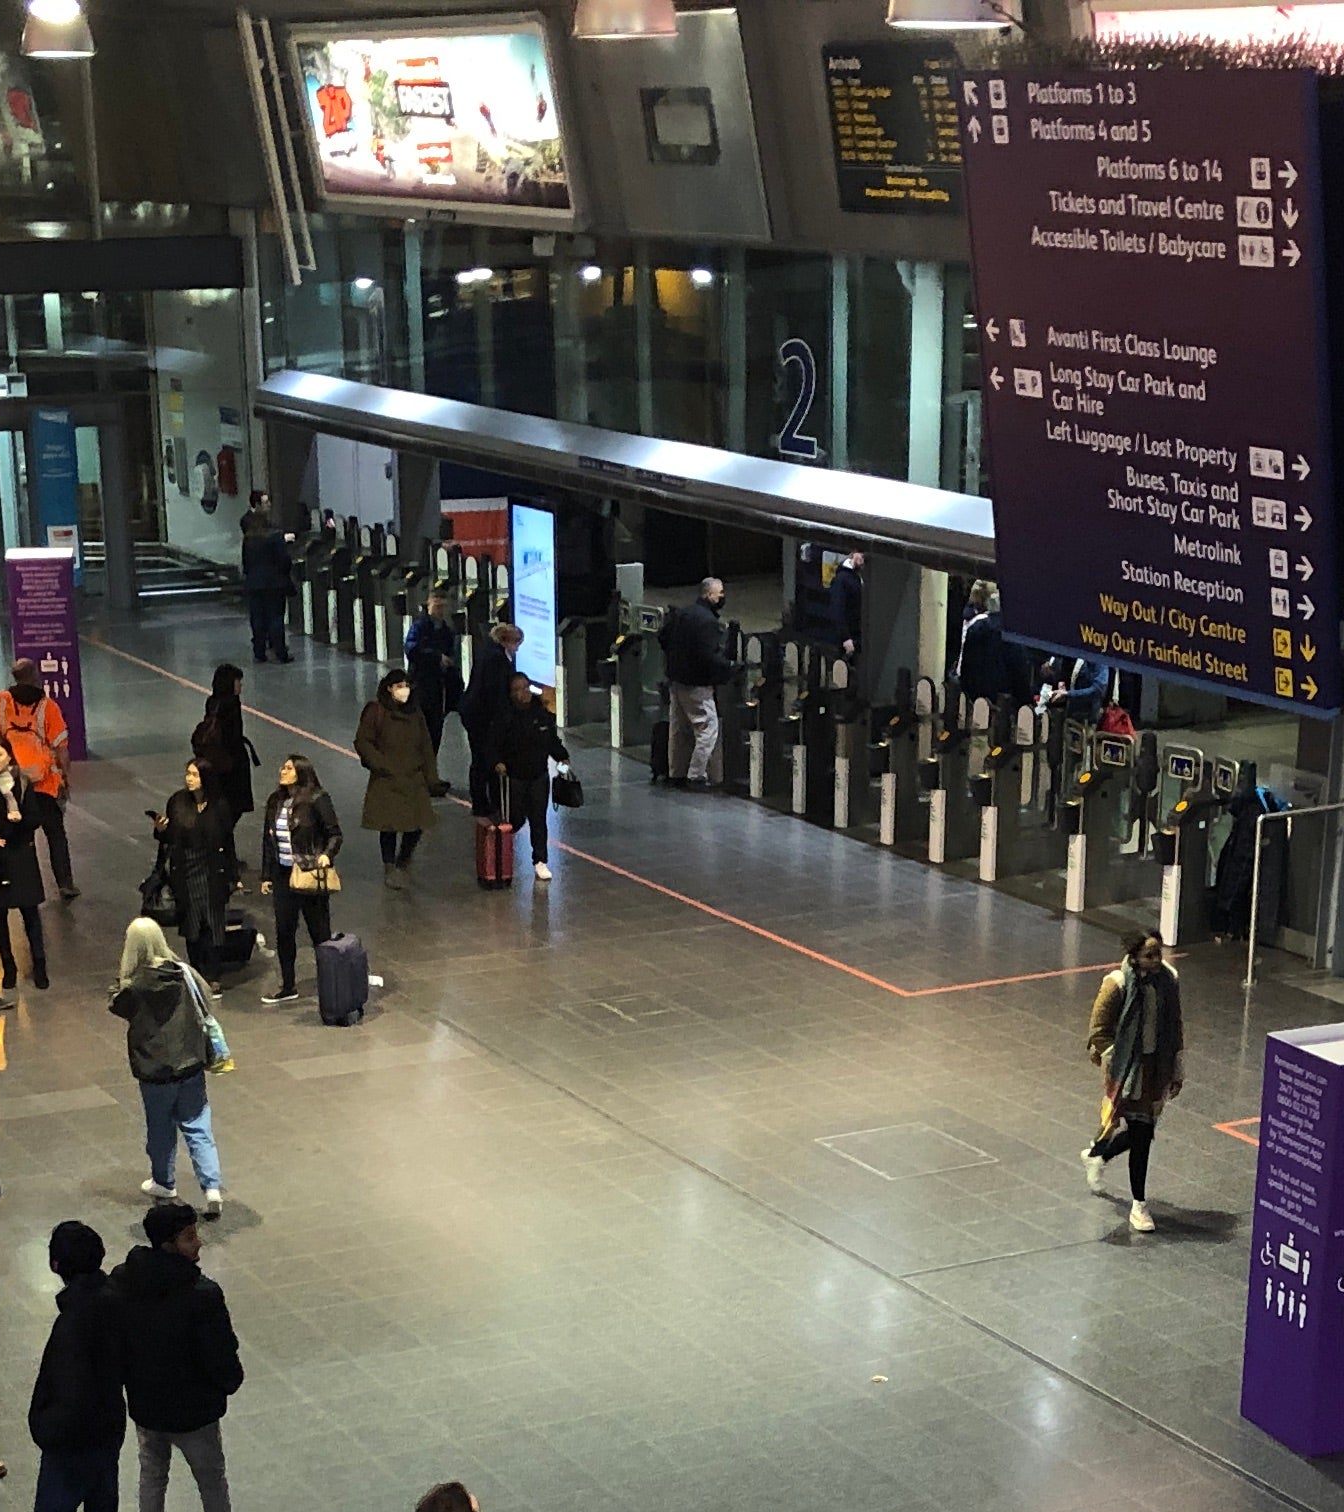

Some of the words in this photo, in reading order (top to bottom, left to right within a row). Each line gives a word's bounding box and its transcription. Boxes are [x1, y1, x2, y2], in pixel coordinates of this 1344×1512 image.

[1027, 82, 1092, 104] Platforms
[1097, 83, 1104, 103] 1
[1108, 85, 1126, 104] to
[1127, 82, 1137, 105] 3
[1030, 118, 1095, 141] Platforms
[1098, 119, 1107, 141] 4
[1111, 120, 1137, 142] and
[1142, 120, 1152, 143] 5
[1097, 157, 1165, 180] Platforms
[1168, 158, 1178, 181] 6
[1182, 160, 1199, 181] to
[1203, 160, 1223, 181] 14
[1049, 191, 1096, 215] Tickets
[1099, 194, 1125, 216] and
[1129, 194, 1171, 218] Travel
[1175, 197, 1224, 221] Centre
[1032, 226, 1097, 250] Accessible
[1100, 229, 1145, 253] Toilets
[1159, 233, 1226, 262] Babycare
[1048, 326, 1089, 350] Avanti
[1092, 330, 1122, 353] First
[1125, 334, 1160, 359] Class
[1164, 338, 1217, 368] Lounge
[778, 338, 817, 458] 2
[1050, 362, 1082, 390] Long
[1085, 366, 1115, 394] Stay
[1118, 370, 1140, 392] Car
[1144, 373, 1175, 397] Park
[1179, 378, 1205, 401] and
[1053, 389, 1073, 411] Car
[1077, 392, 1104, 415] Hire
[1046, 419, 1071, 442] Left
[1075, 424, 1132, 456] Luggage
[1144, 434, 1172, 457] Lost
[1176, 439, 1237, 472] Property
[1126, 466, 1168, 494] Buses,
[1173, 472, 1208, 497] Taxis
[1211, 479, 1239, 503] and
[1108, 488, 1143, 514] Short
[1147, 495, 1177, 525] Stay
[1182, 501, 1205, 524] Car
[1209, 505, 1240, 530] Park
[1174, 534, 1242, 565] Metrolink
[1121, 560, 1170, 589] Station
[1175, 570, 1244, 605] Reception
[1099, 593, 1129, 623] Way
[1133, 601, 1157, 624] Out
[1169, 609, 1196, 637] City
[1200, 616, 1246, 644] Centre
[1080, 624, 1107, 653] Way
[1112, 632, 1136, 656] Out
[1148, 640, 1201, 671] Fairfield
[1206, 653, 1248, 682] Street
